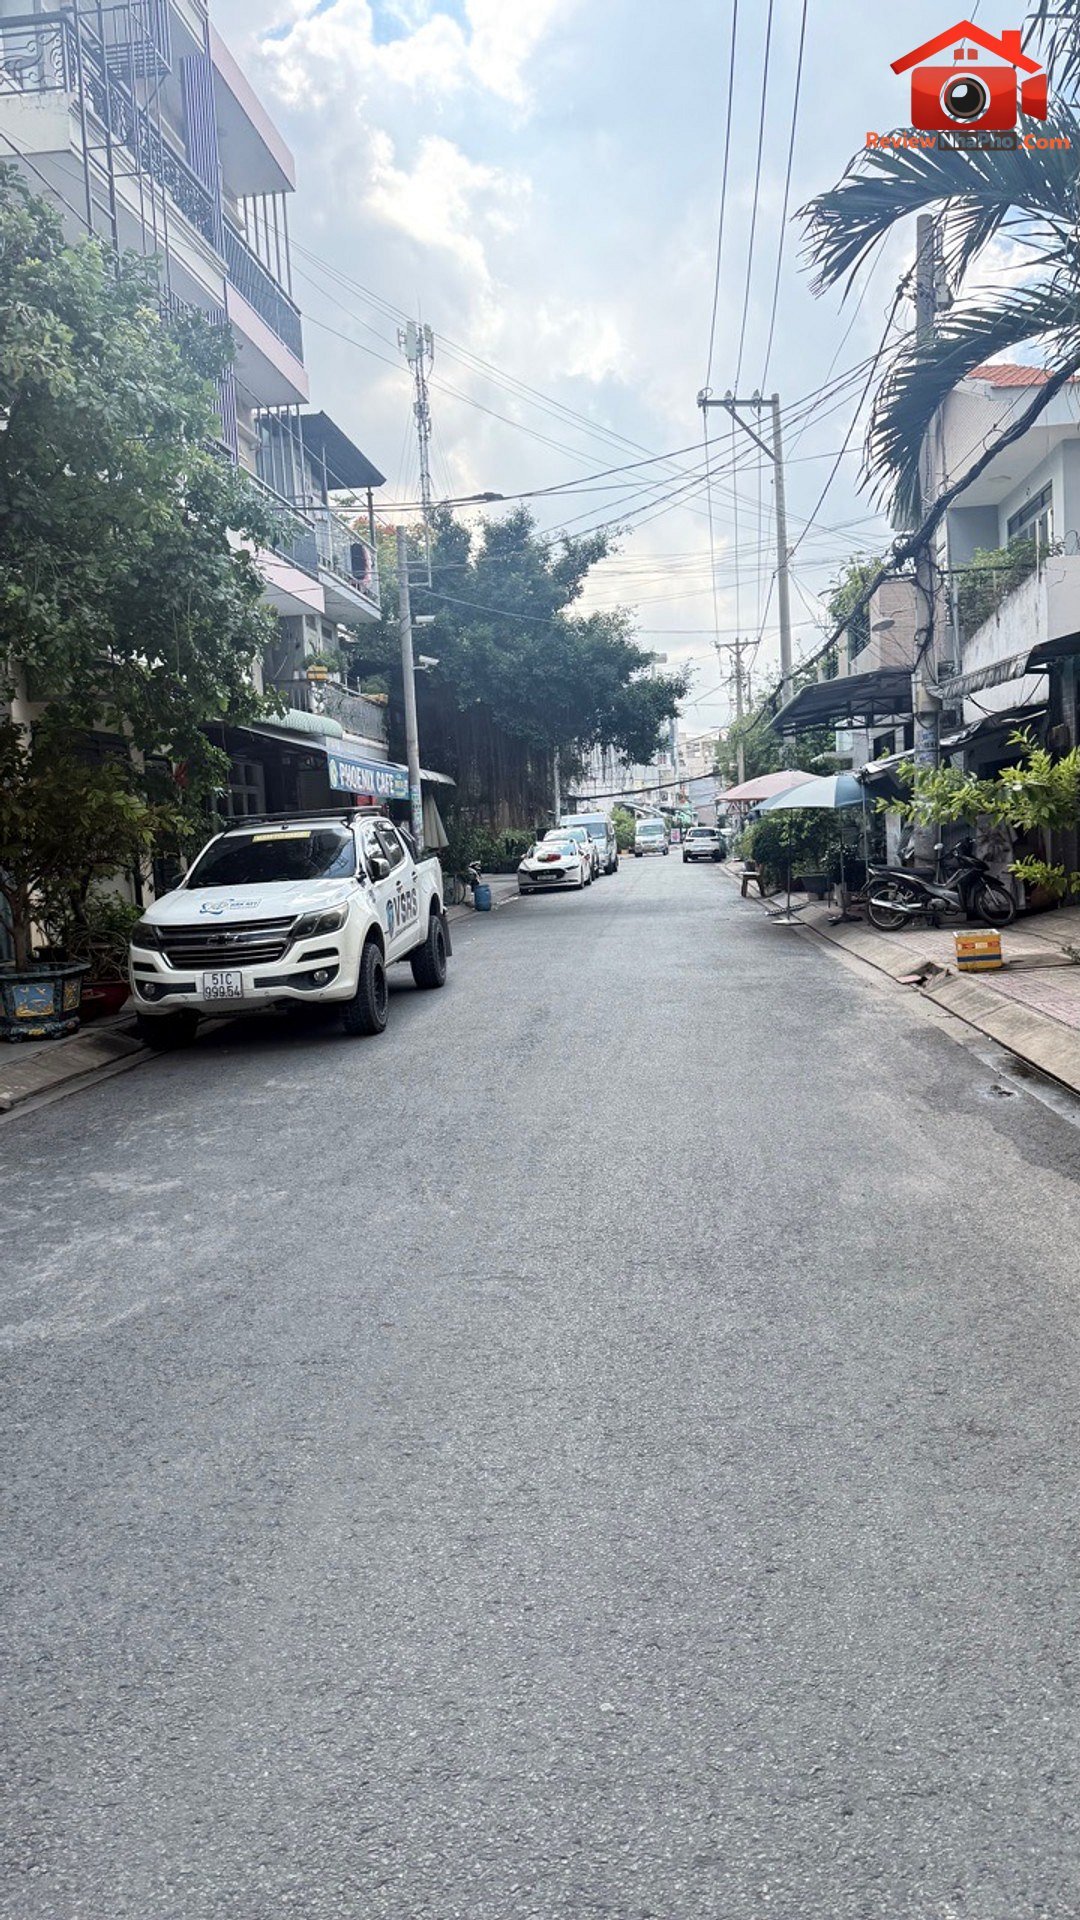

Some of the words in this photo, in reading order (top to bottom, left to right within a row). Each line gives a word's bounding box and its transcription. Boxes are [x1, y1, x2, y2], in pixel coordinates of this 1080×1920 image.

[339, 761, 375, 793] PHOENIX
[376, 770, 395, 794] CAFE
[211, 973, 232, 985] 51C
